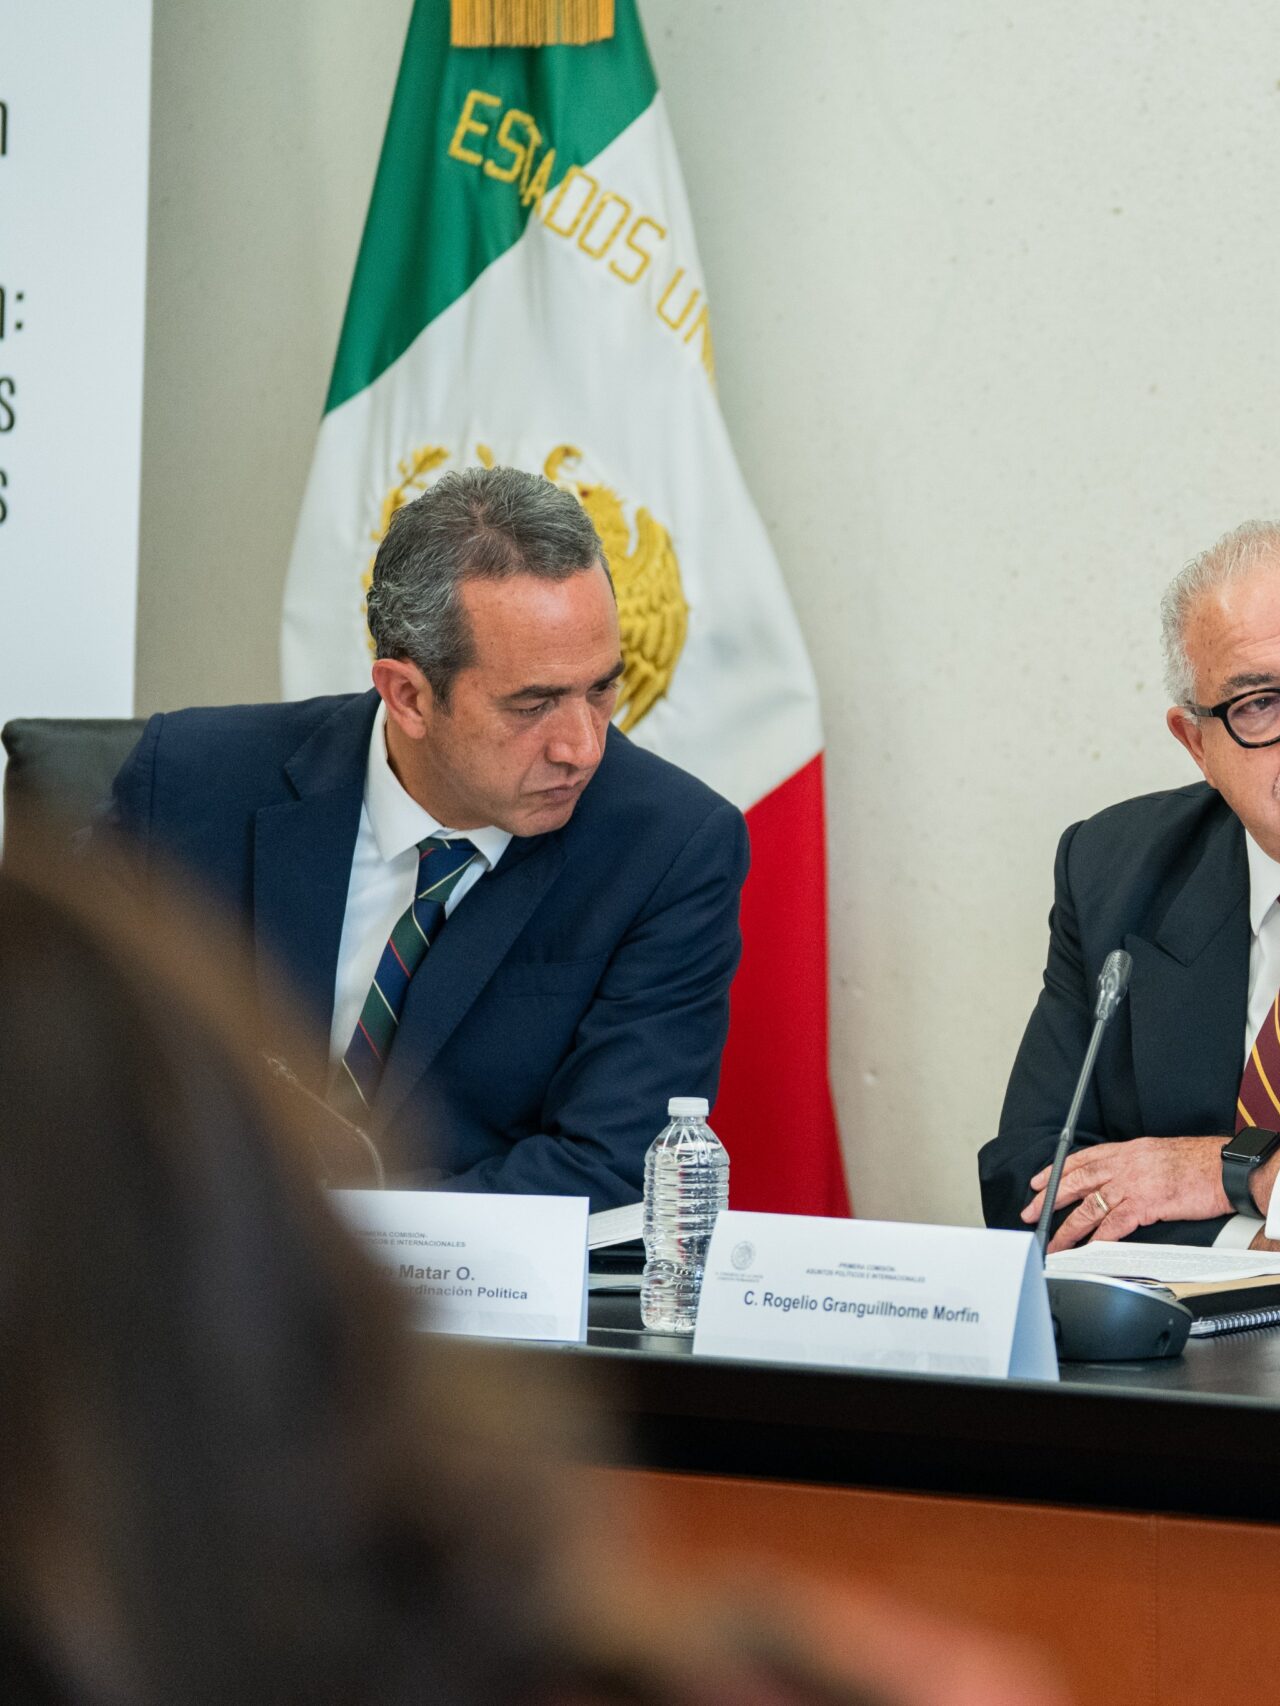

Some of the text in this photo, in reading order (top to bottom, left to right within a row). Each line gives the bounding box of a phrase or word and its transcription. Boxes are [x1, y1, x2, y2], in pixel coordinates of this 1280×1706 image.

[449, 90, 667, 285] ESTADOS
[400, 1264, 450, 1280] Matar
[456, 1266, 475, 1281] O.
[744, 1290, 758, 1306] C.
[763, 1292, 818, 1313] Rogelio
[822, 1297, 929, 1320] Granguillhome
